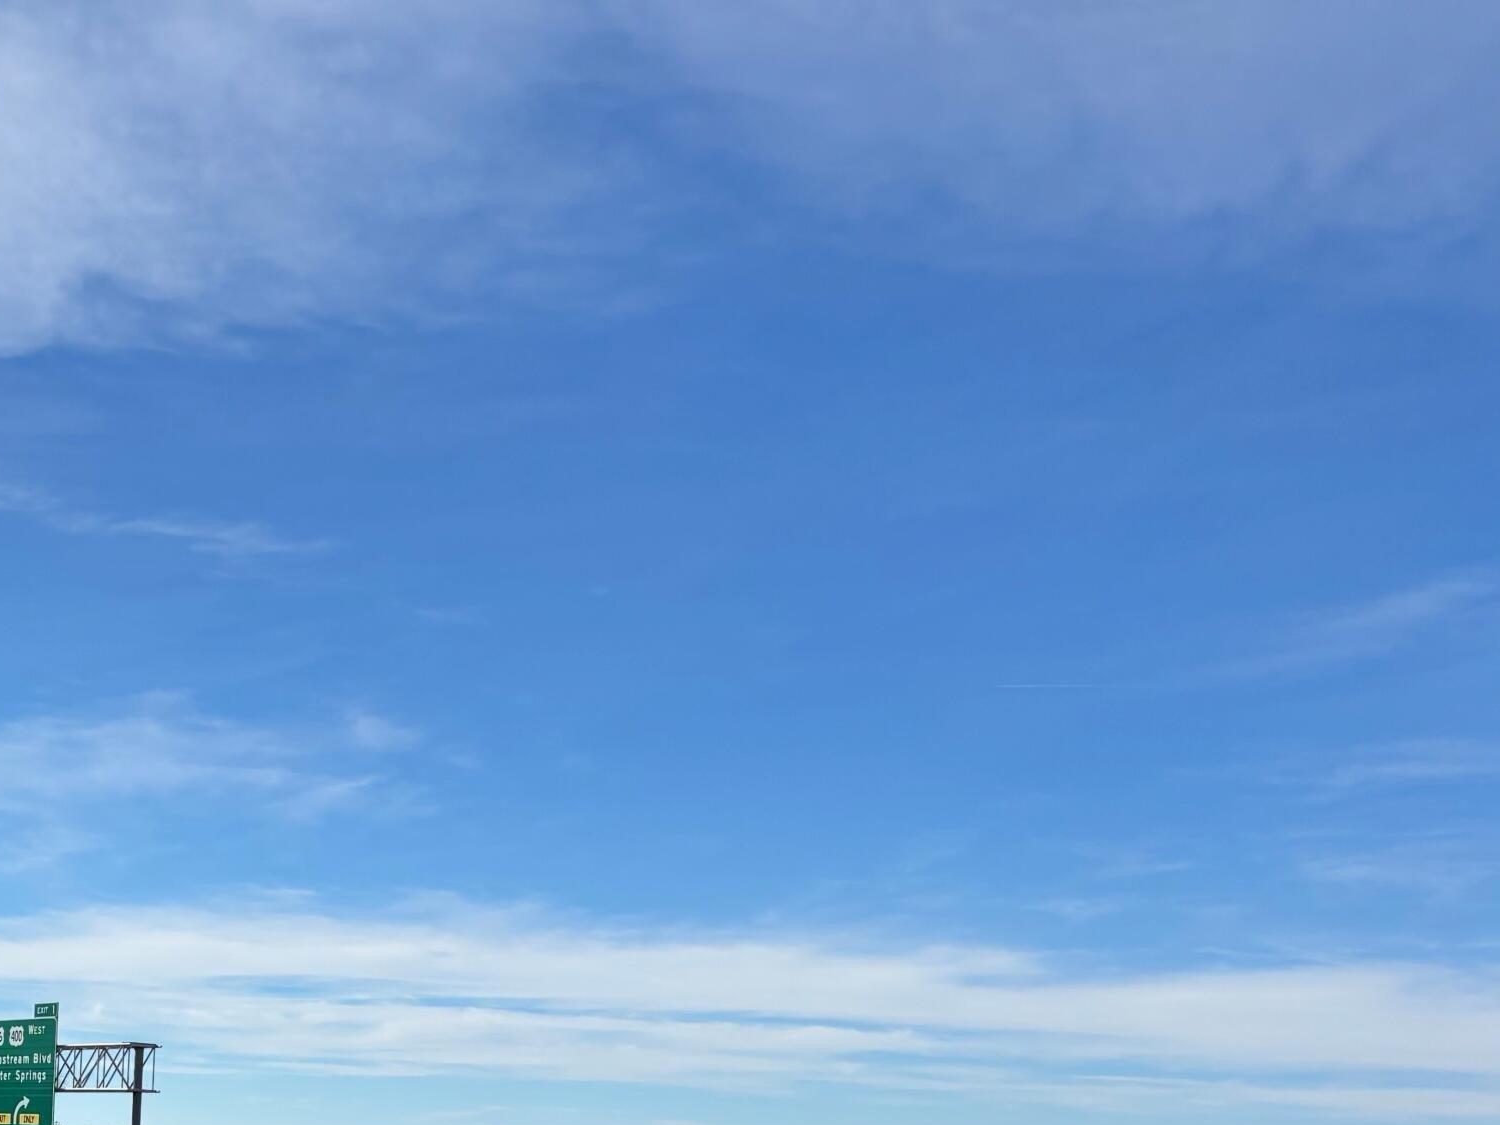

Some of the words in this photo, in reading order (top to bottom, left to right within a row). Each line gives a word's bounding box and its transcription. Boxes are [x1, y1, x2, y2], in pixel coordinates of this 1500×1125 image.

[37, 1007, 48, 1015] EXIT
[11, 1031, 22, 1042] 400
[28, 1025, 46, 1035] WEST
[33, 1053, 52, 1064] Blvd
[15, 1070, 46, 1083] Springs
[23, 1115, 36, 1123] ONLY
